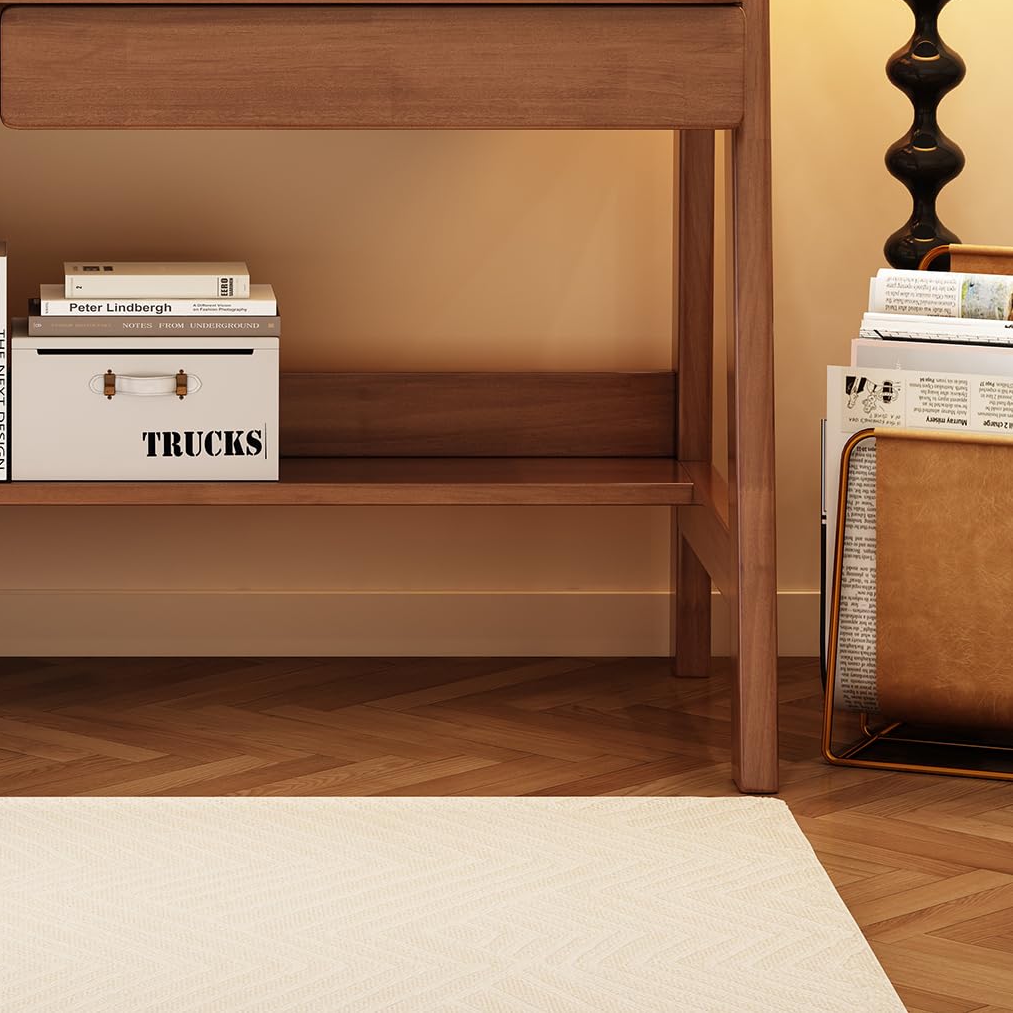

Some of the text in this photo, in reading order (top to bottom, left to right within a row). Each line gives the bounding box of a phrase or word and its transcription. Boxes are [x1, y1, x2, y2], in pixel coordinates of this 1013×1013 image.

[220, 278, 228, 297] EERO
[69, 302, 172, 314] Peter Lindbergh
[926, 416, 968, 426] Murray misery
[983, 420, 1004, 428] charge
[142, 430, 263, 457] TRUCKS
